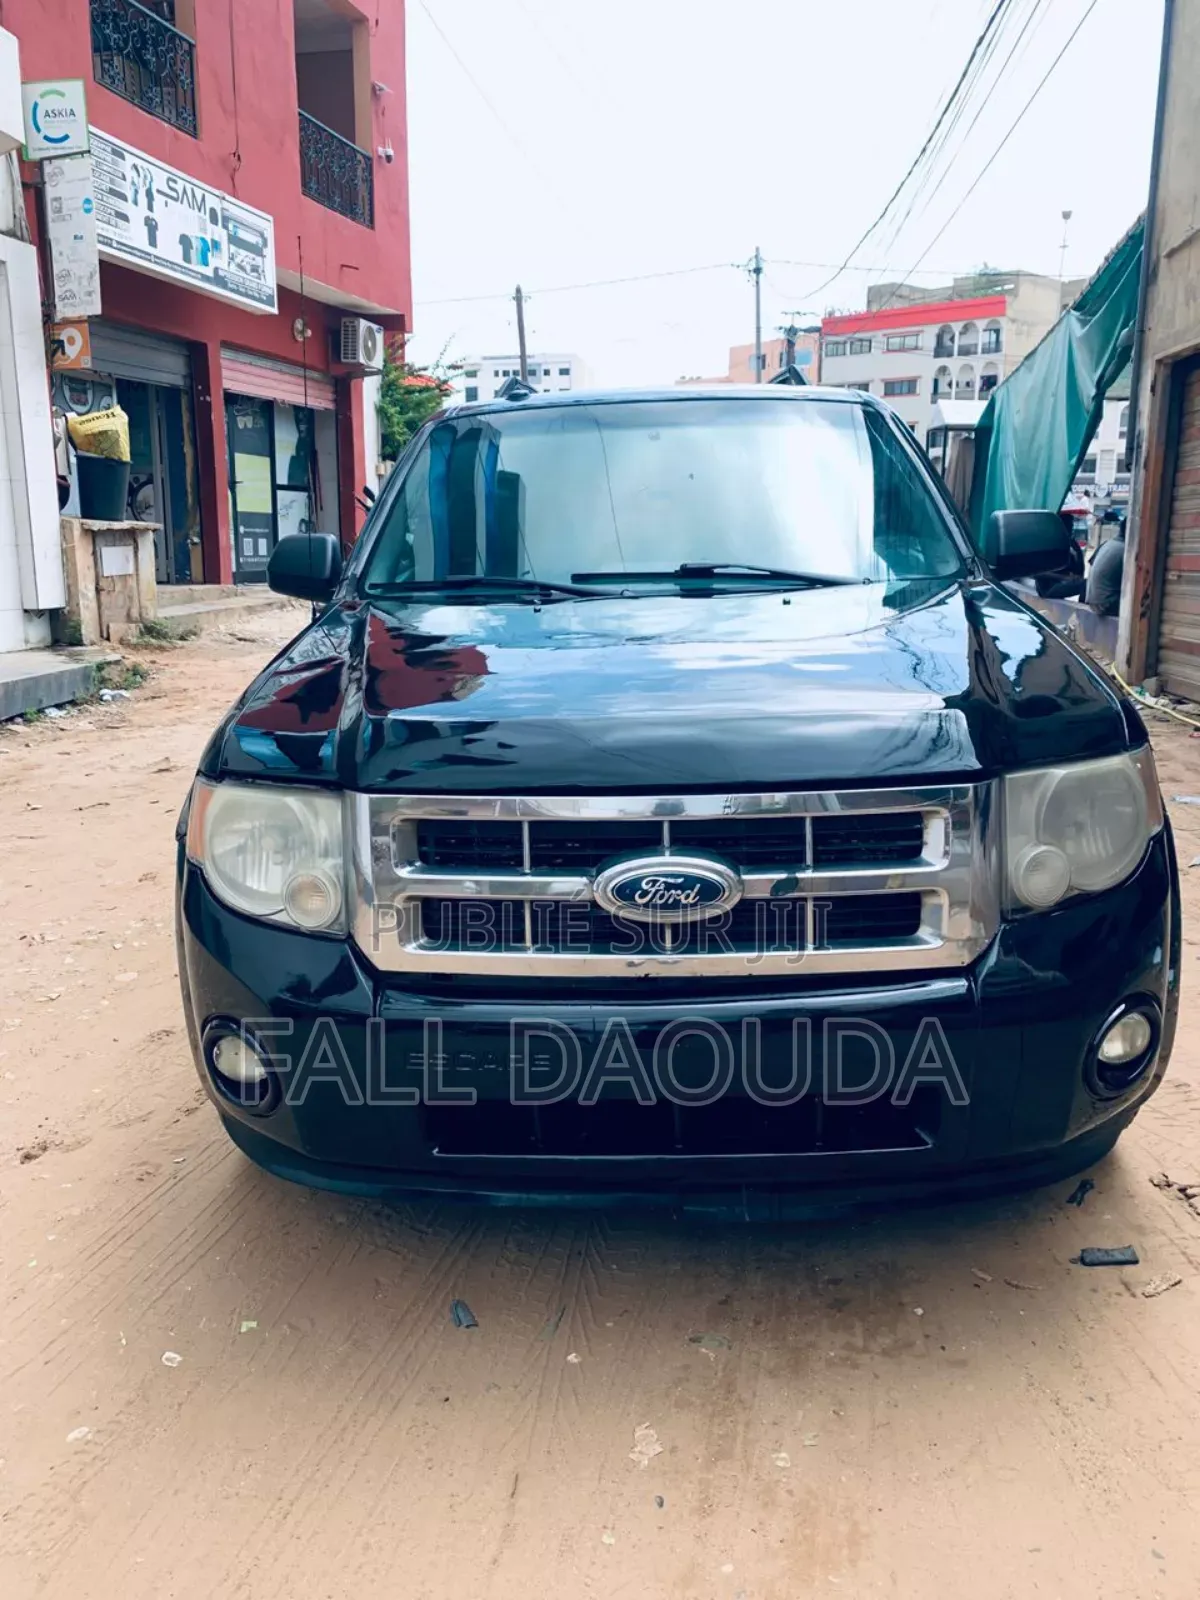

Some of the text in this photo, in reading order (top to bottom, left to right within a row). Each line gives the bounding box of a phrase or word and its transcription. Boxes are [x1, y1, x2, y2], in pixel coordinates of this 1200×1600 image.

[43, 108, 76, 119] ASKIA
[156, 176, 207, 215] SAM
[58, 292, 77, 303] SAM
[634, 876, 701, 905] Ford
